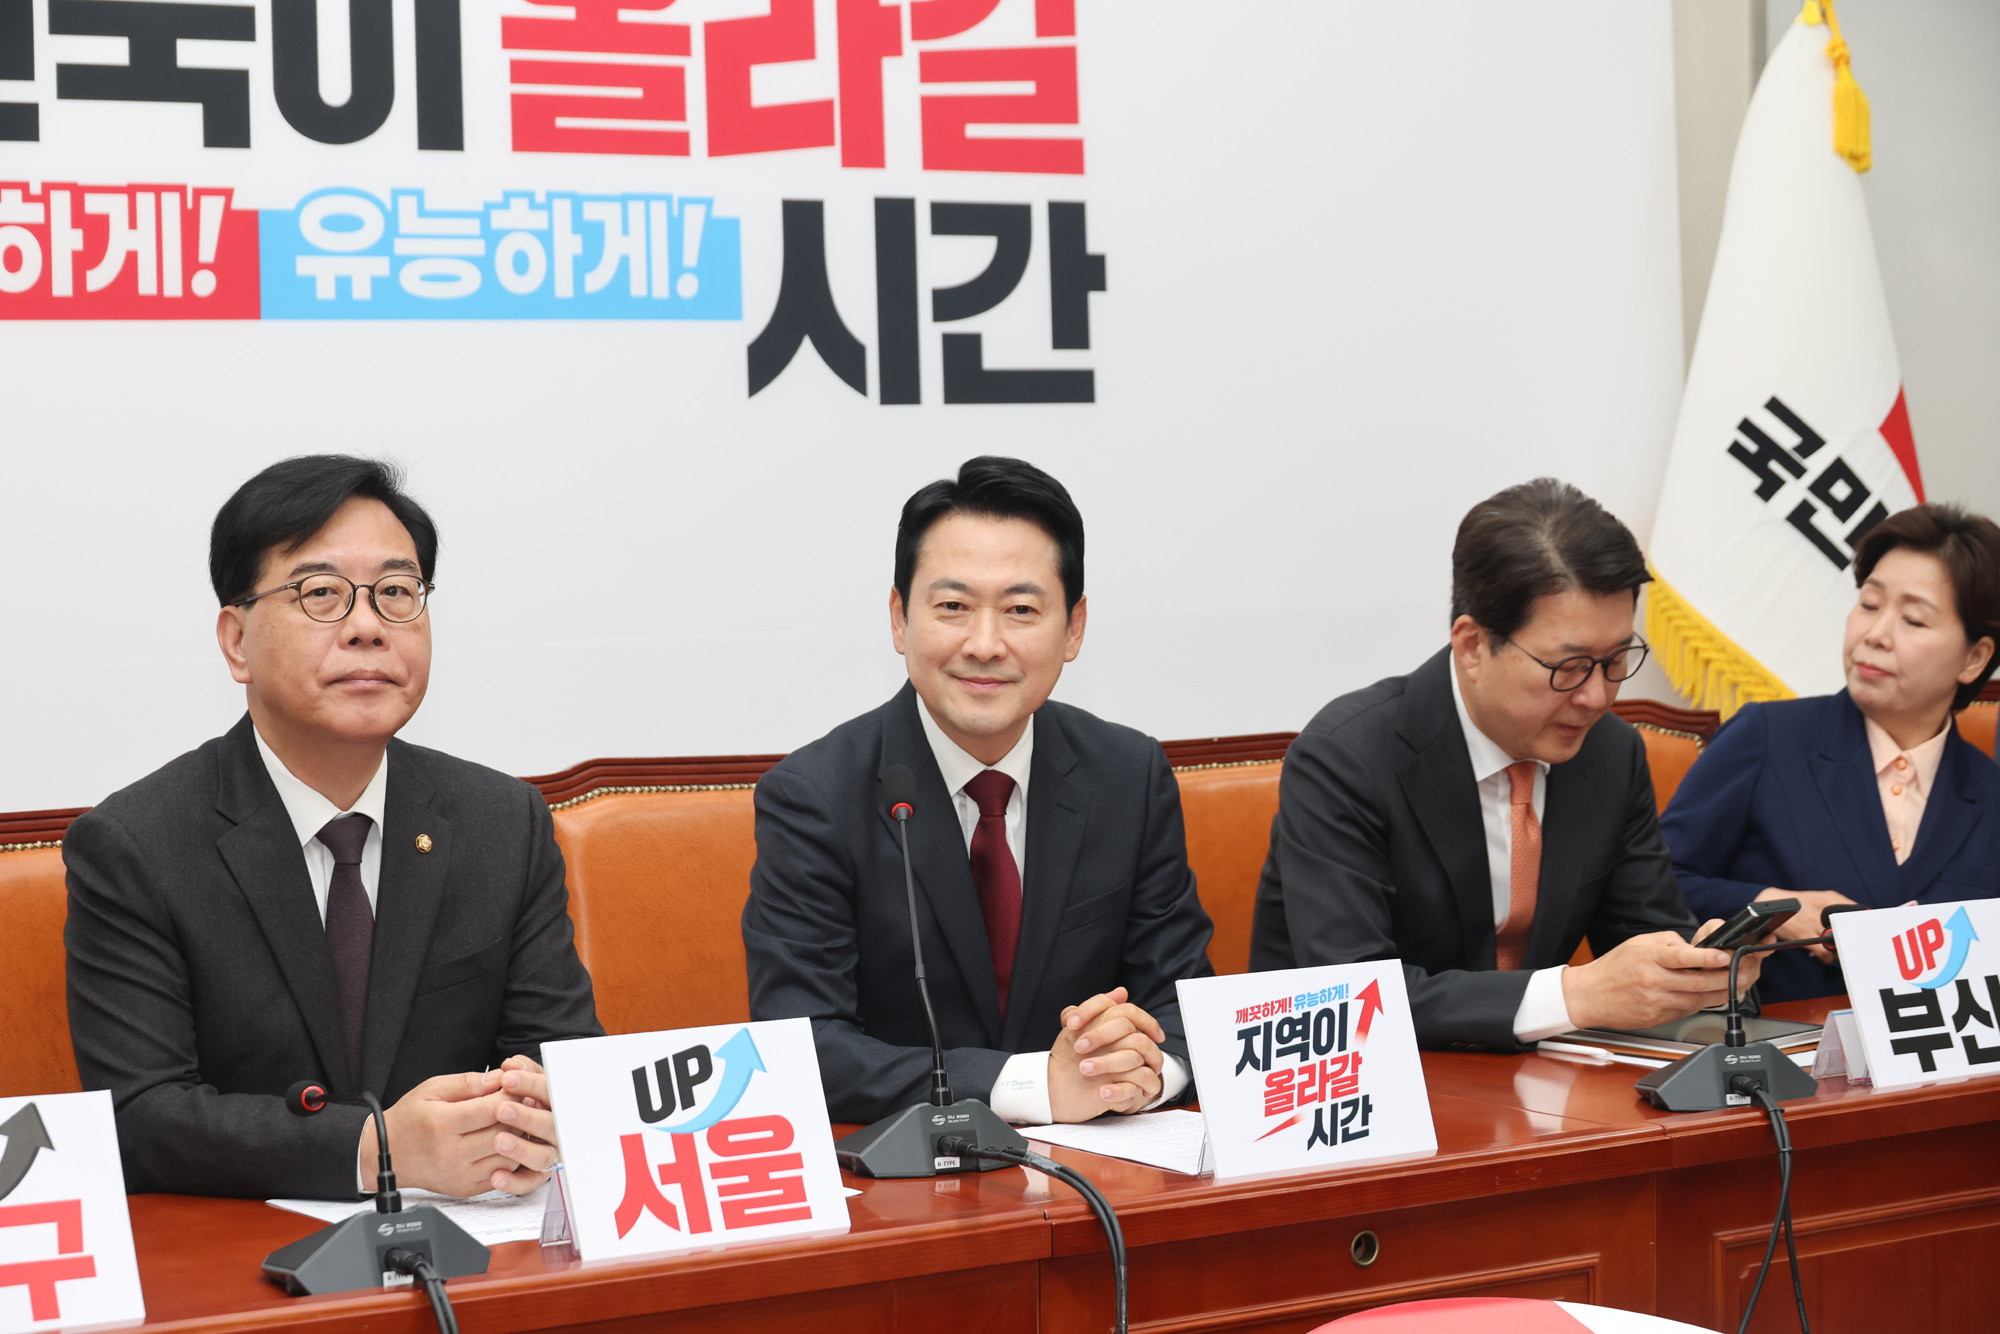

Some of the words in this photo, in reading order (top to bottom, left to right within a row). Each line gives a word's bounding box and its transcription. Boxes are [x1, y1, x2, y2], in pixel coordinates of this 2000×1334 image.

[296, 193, 709, 300] 유능하게!
[747, 196, 1107, 405] 시간
[1892, 918, 1945, 981] UP
[1235, 996, 1293, 1024] 깨끗하게!
[1294, 983, 1350, 1011] 유능하게!
[1235, 1001, 1349, 1077] 지역이
[632, 1044, 713, 1125] UP
[1264, 1051, 1363, 1118] 올라갈
[1307, 1094, 1373, 1151] 시간
[614, 1114, 812, 1240] 서울
